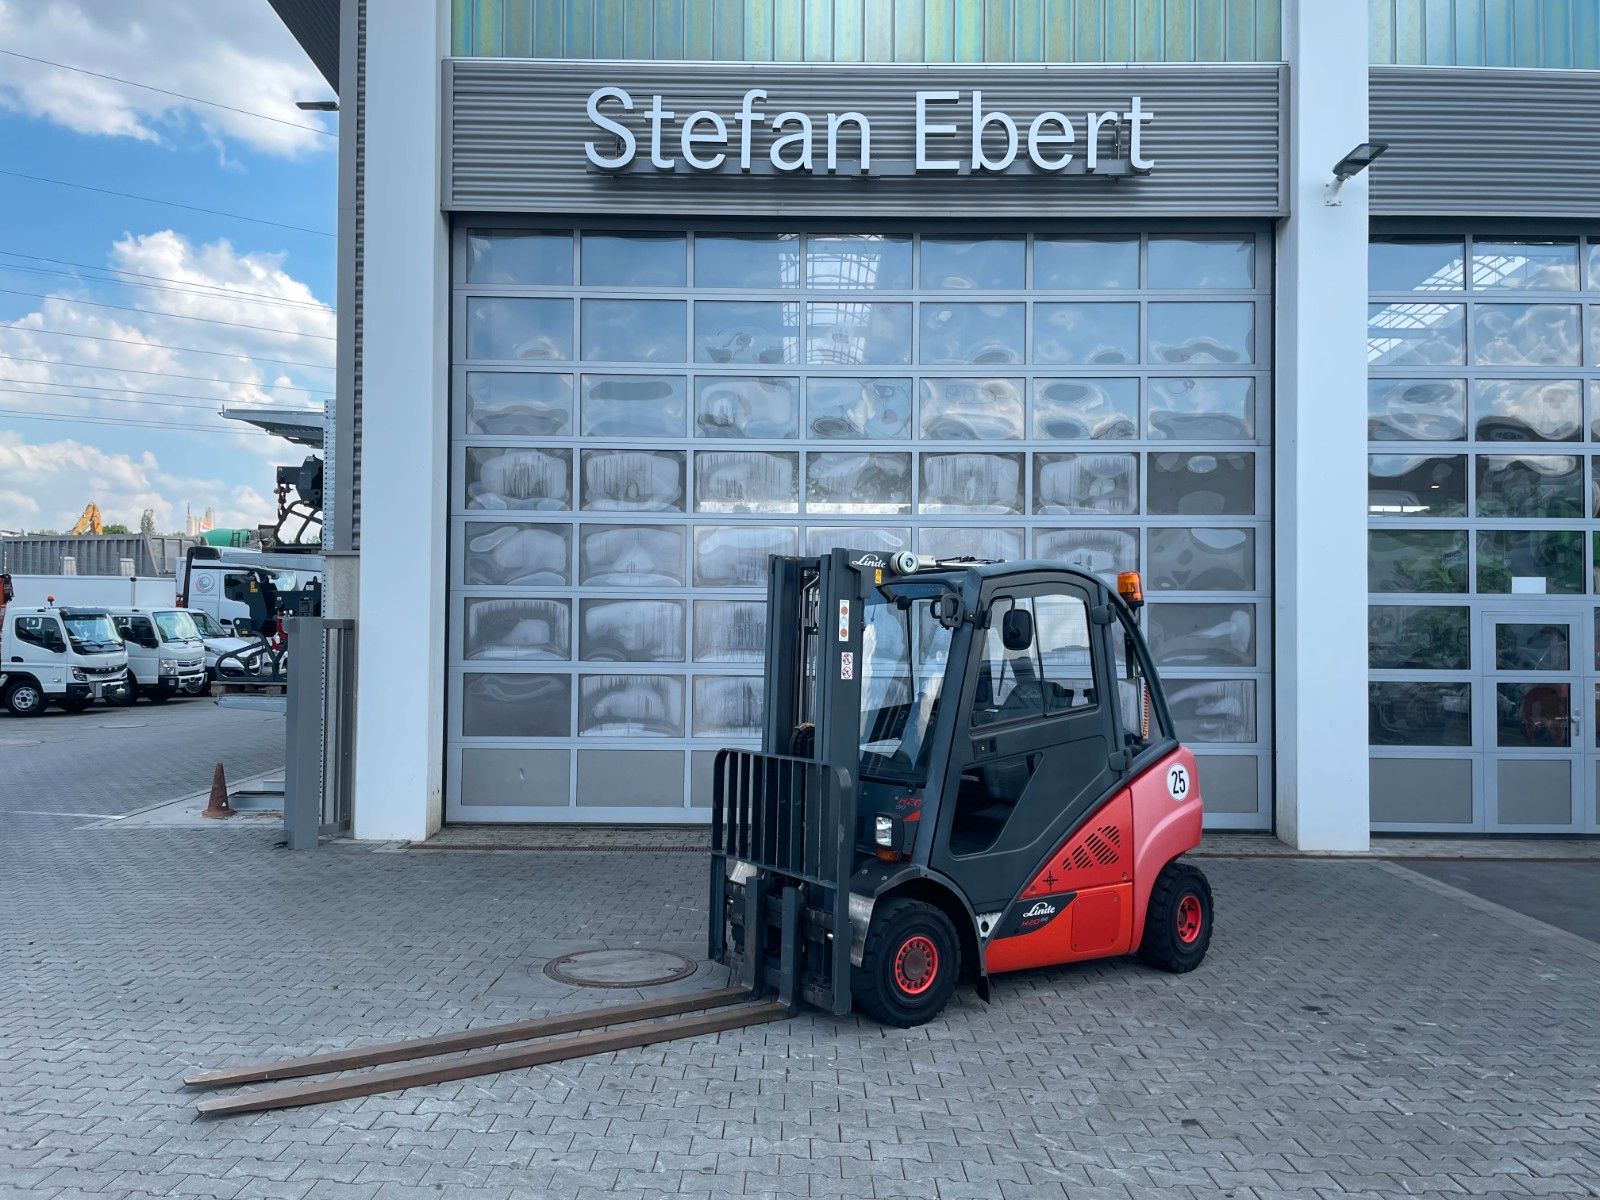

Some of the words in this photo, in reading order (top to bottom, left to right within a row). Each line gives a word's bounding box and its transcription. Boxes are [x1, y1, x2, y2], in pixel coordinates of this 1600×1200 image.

[584, 86, 870, 174] Stefan
[915, 89, 1154, 175] Ebert
[852, 553, 887, 568] Linde
[1171, 770, 1186, 794] 25
[1022, 901, 1056, 918] Linde
